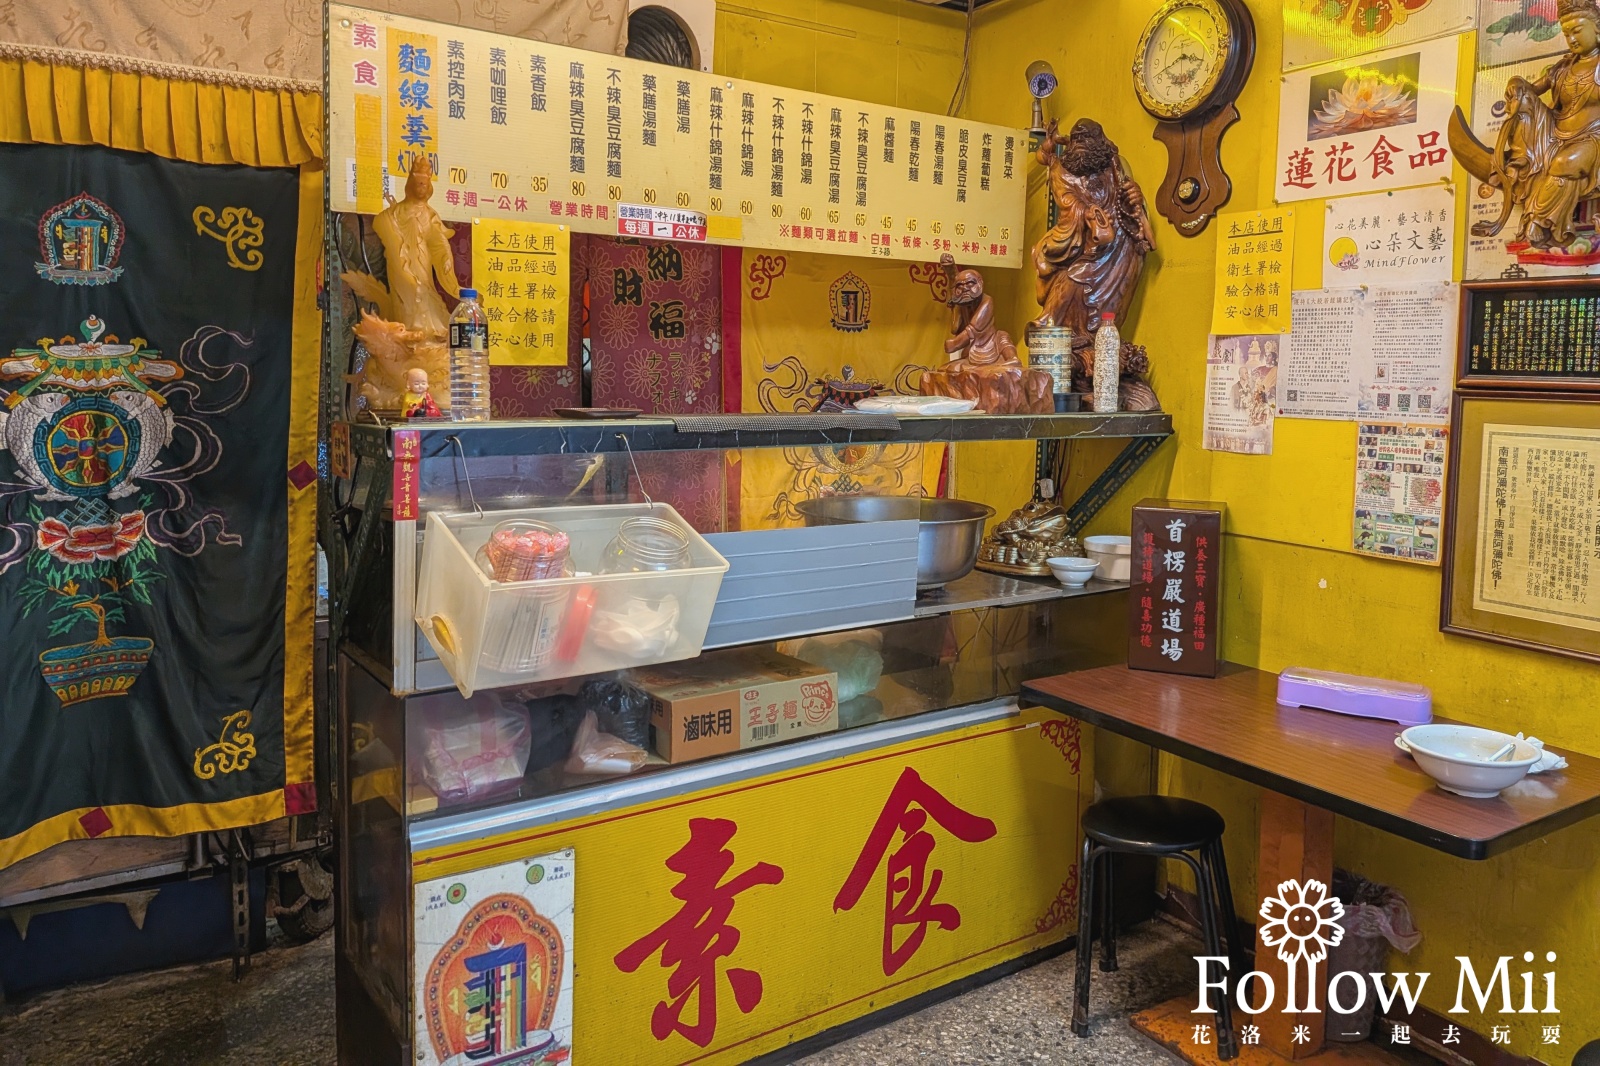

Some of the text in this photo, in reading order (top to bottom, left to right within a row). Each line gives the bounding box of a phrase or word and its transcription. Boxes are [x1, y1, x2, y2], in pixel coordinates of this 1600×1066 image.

[1168, 27, 1175, 38] 11
[1206, 27, 1212, 39] 2
[1158, 40, 1167, 51] 10
[353, 23, 378, 87] 素食
[1153, 58, 1160, 69] 9
[1204, 63, 1210, 74] 4
[447, 40, 466, 120] 素控肉飯
[489, 47, 508, 126] 素咖哩飯
[530, 54, 547, 113] 素香飯
[1156, 74, 1163, 85] 8
[1193, 80, 1199, 91] 5
[397, 43, 432, 148] 麵線羹
[1166, 85, 1171, 96] 7
[1179, 88, 1185, 99] 6
[642, 74, 657, 147] 藥膳湯麵
[676, 80, 691, 134] 藥膳湯
[568, 61, 586, 174] 麻辣臭豆腐麵
[606, 68, 622, 178] 不辣臭豆腐麵
[709, 87, 723, 190] 麻辣什錦湯麵
[740, 92, 754, 177] 麻辣什錦湯
[883, 116, 896, 164] 麻醬麵
[771, 97, 785, 197] 不辣什錦湯麵
[800, 103, 814, 185] 不辣什錦湯
[908, 120, 921, 182] 陽春乾麵
[828, 108, 842, 204] 麻辣臭豆腐湯
[855, 112, 869, 207] 不辣臭豆腐湯
[932, 124, 946, 185] 陽春湯麵
[980, 132, 992, 191] 炸蘿蔔糕
[1003, 136, 1014, 180] 燙青菜
[1283, 130, 1448, 190] 蓮花食品
[956, 128, 969, 203] 脆皮臭豆腐
[451, 168, 466, 184] 70
[492, 172, 507, 189] 70
[532, 177, 547, 192] 35
[572, 181, 585, 197] 80
[608, 186, 621, 201] 80
[643, 189, 656, 204] 80
[445, 189, 528, 213] 每週一公休
[677, 192, 690, 207] 60
[710, 198, 722, 212] 80
[741, 201, 753, 215] 60
[771, 205, 783, 218] 80
[800, 208, 812, 221] 60
[828, 211, 839, 224] 65
[855, 213, 866, 226] 65
[882, 216, 892, 230] 45
[907, 219, 917, 231] 45
[931, 221, 941, 234] 45
[955, 224, 965, 236] 65
[1228, 216, 1283, 235] 本店使用
[978, 226, 987, 238] 35
[1000, 228, 1009, 240] 35
[1365, 226, 1447, 253] 心朵文藝
[487, 231, 555, 251] 本店使用
[1227, 239, 1283, 256] 油品經過
[487, 257, 557, 275] 油品經過
[1226, 261, 1282, 278] 衛生署檢
[487, 281, 557, 300] 衛生署檢
[1224, 282, 1281, 298] 驗合格請
[487, 307, 556, 325] 驗合格請
[1224, 303, 1279, 319] 安心使用
[488, 331, 555, 348] 安心使用
[1160, 518, 1187, 662] 首楞嚴道場
[801, 683, 830, 699] Prince
[747, 700, 798, 728] 王子麵
[683, 708, 732, 743] 滷味用
[614, 766, 997, 1049] 素食
